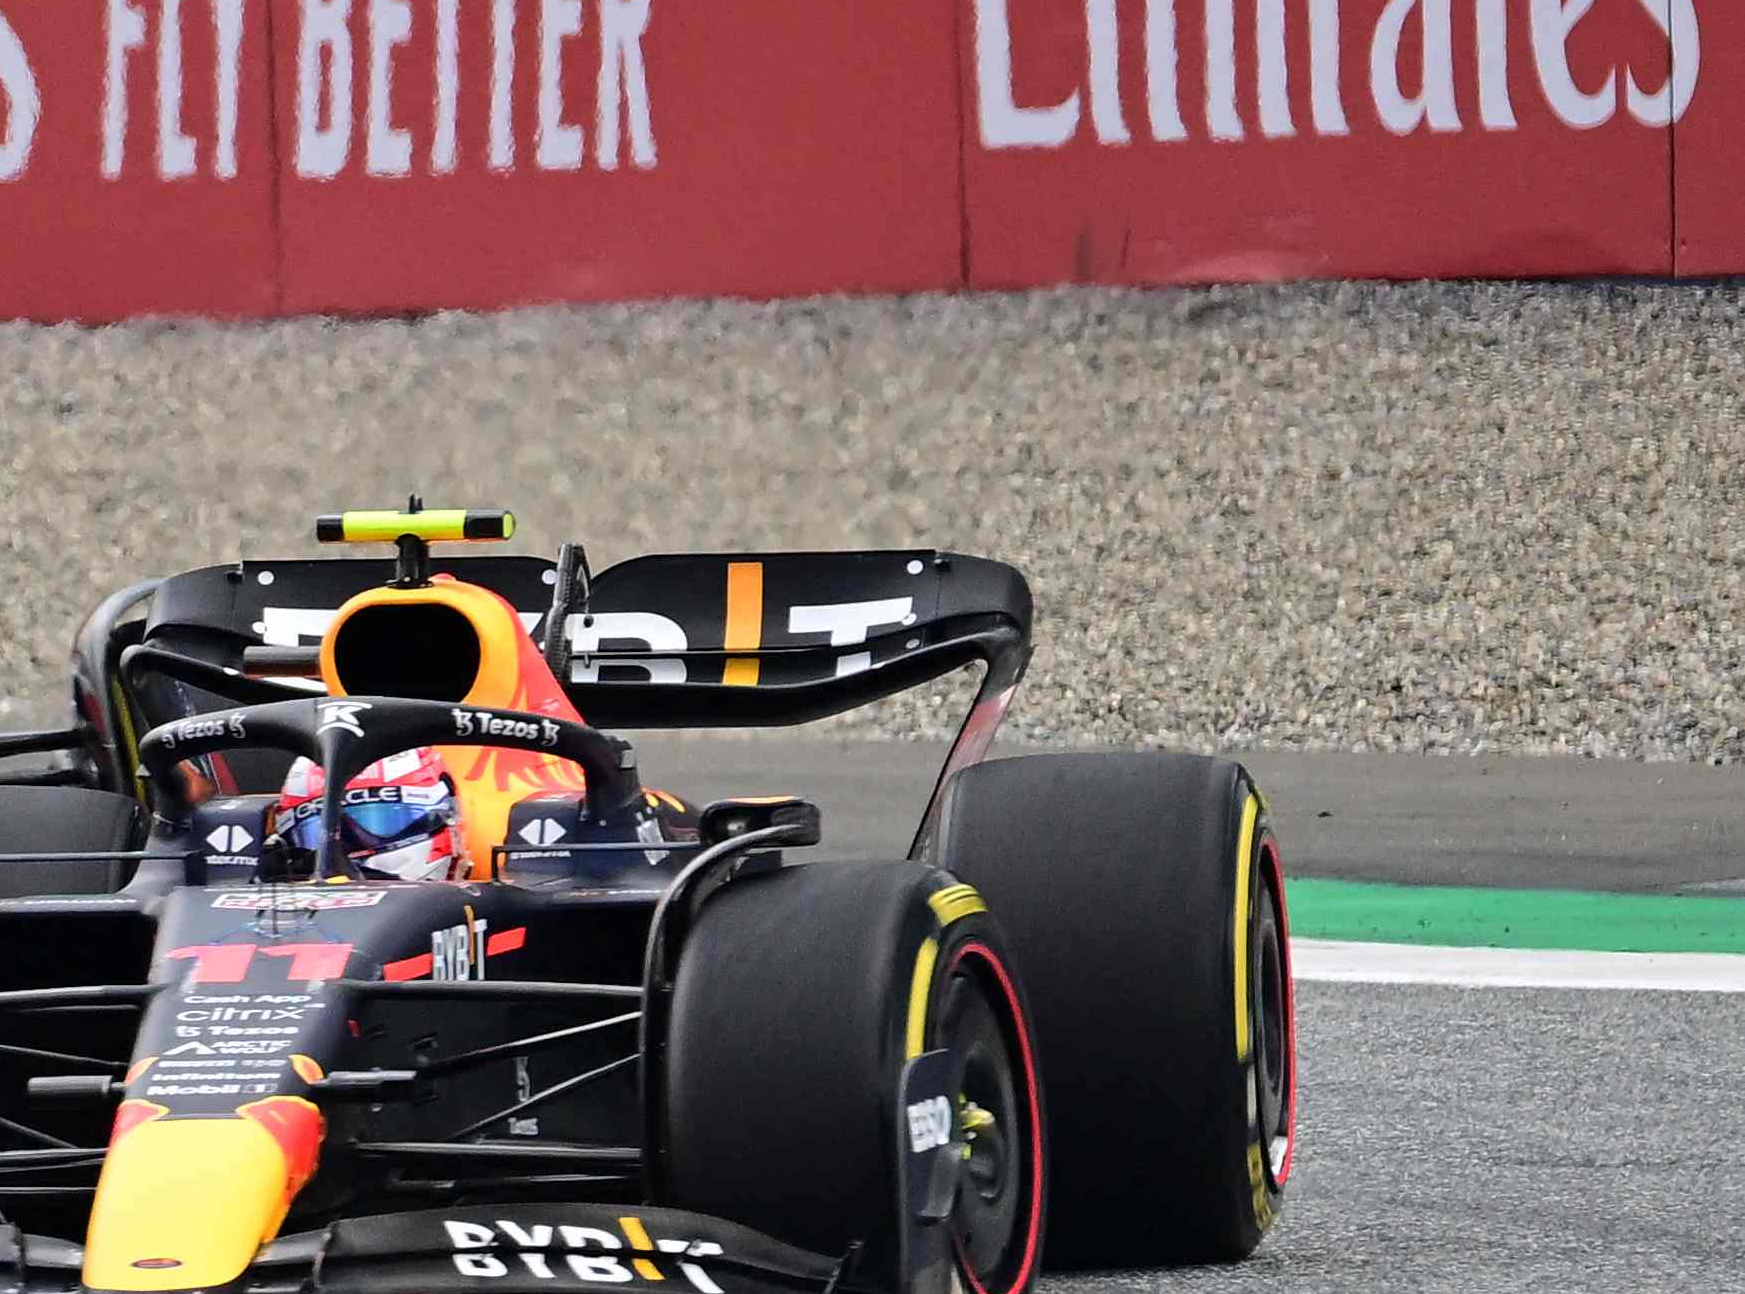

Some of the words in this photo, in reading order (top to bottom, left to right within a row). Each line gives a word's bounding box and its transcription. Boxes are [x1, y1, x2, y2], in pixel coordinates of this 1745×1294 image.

[177, 718, 225, 741] Tezos
[479, 712, 538, 739] Tezos
[431, 905, 488, 981] BYBIT
[166, 944, 354, 983] 11
[182, 994, 250, 1004] Cash
[252, 994, 313, 1005] App
[176, 1007, 306, 1022] citrix
[209, 1025, 299, 1036] Tezos
[210, 1040, 293, 1048] ARCTIC
[218, 1047, 283, 1055] WOLF
[146, 1084, 241, 1096] Mobil
[443, 1216, 726, 1294] BYBIT
